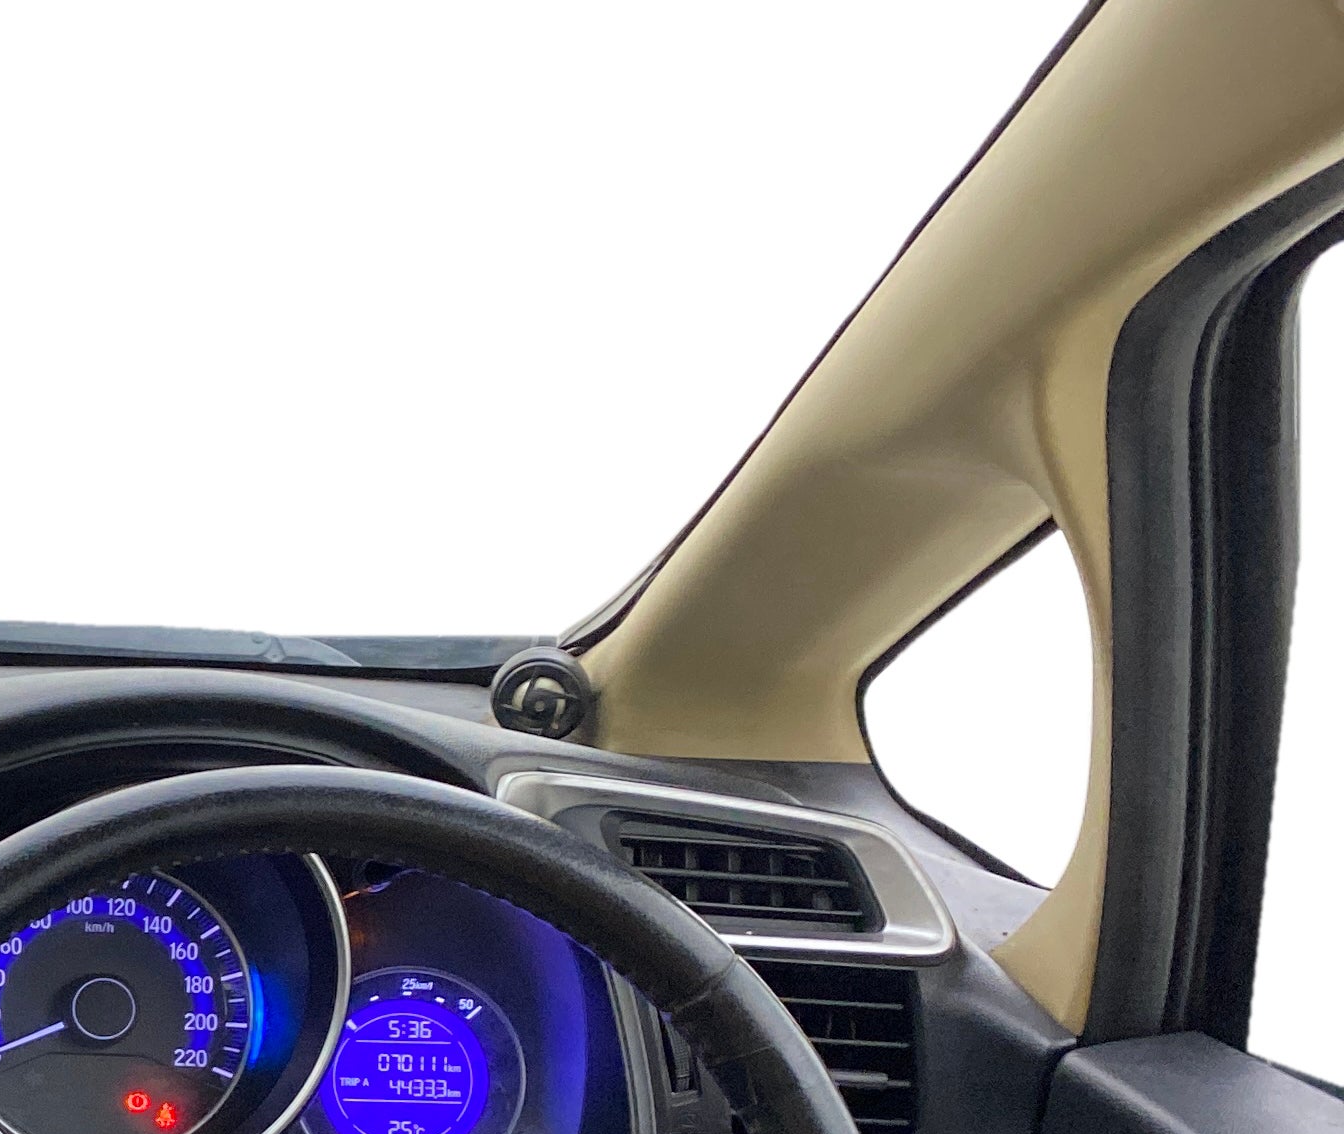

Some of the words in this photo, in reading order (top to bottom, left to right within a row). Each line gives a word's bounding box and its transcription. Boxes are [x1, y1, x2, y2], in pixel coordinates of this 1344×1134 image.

[66, 896, 94, 915] 100
[106, 897, 136, 917] 120
[84, 920, 115, 934] km/h
[142, 915, 173, 934] 140
[0, 936, 23, 955] 60
[168, 941, 199, 961] 160
[184, 974, 214, 994] 180
[458, 998, 474, 1010] 50
[183, 1012, 218, 1031] 200
[387, 1019, 433, 1039] 5:36
[173, 1047, 208, 1068] 220
[339, 1076, 360, 1087] TRIP
[362, 1078, 369, 1087] A
